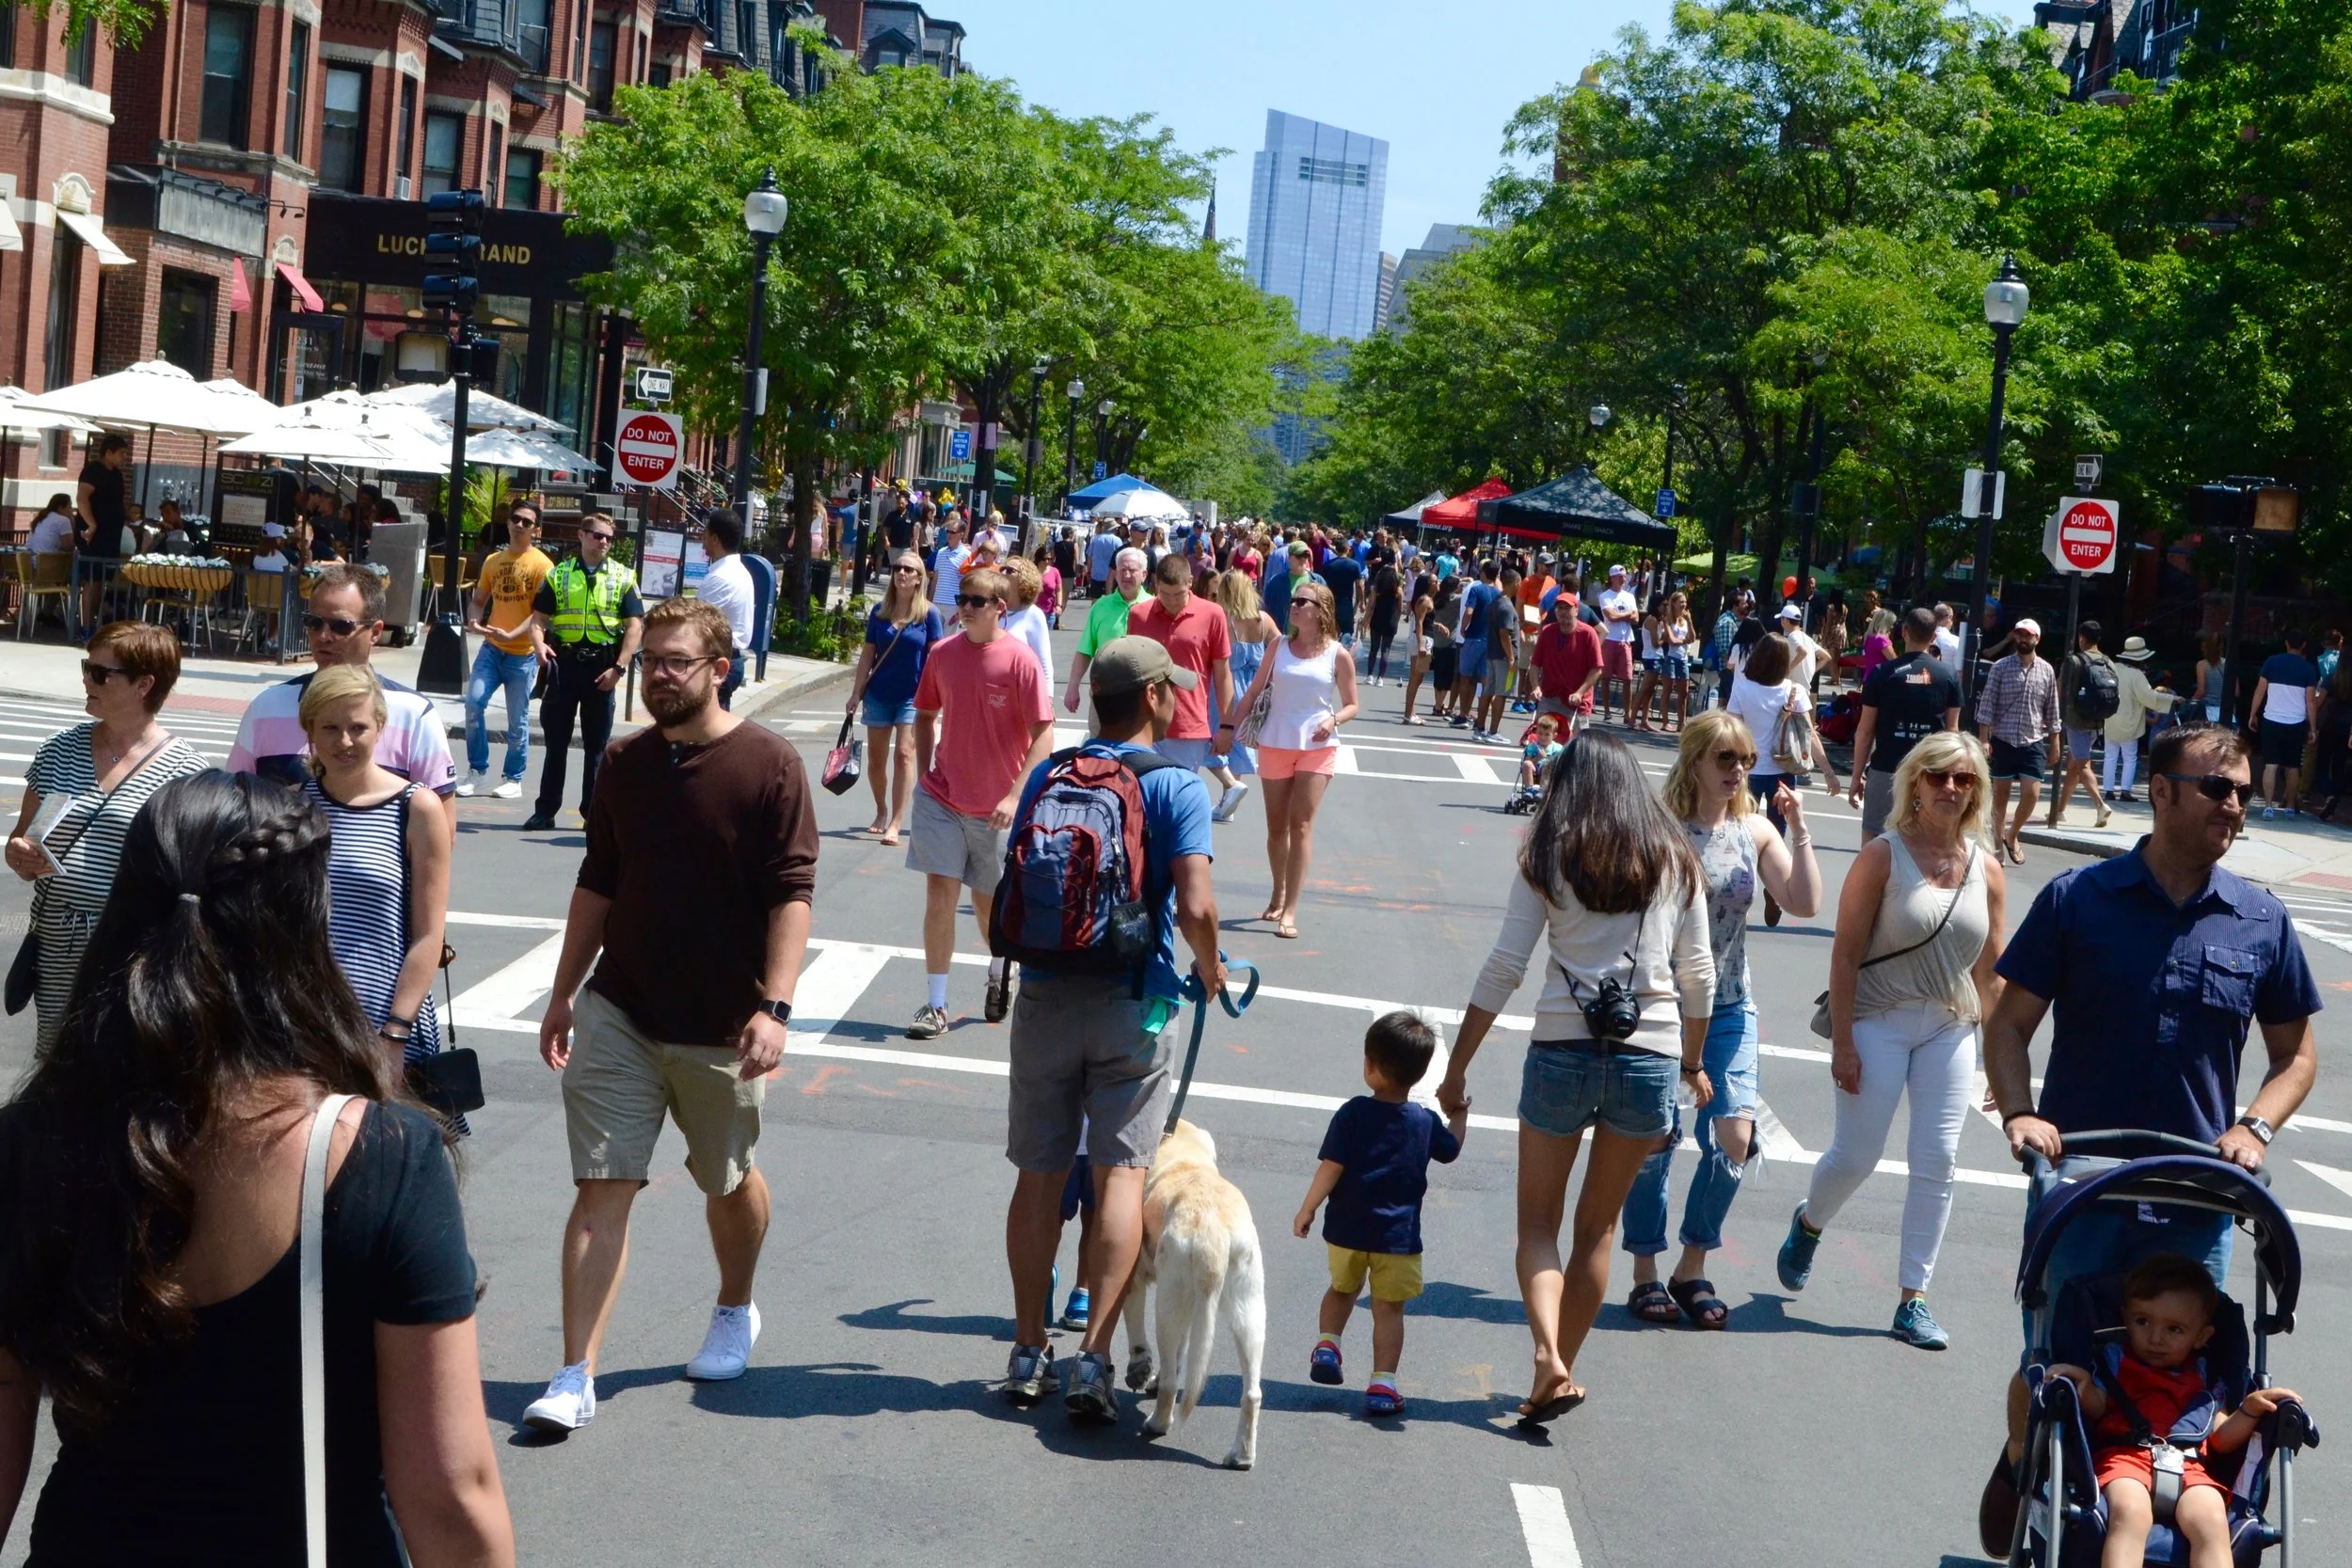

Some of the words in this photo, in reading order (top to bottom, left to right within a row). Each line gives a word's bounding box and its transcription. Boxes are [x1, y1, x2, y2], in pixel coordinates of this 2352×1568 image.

[377, 234, 429, 256] LUC
[480, 243, 532, 265] RAND
[647, 378, 658, 390] ONE
[659, 380, 669, 391] WAY
[627, 427, 644, 439] DO
[647, 430, 672, 443] NOT
[627, 455, 665, 470] ENTER
[2071, 514, 2085, 525] DO
[2088, 515, 2107, 528] NOT
[1593, 526, 1614, 535] SHACK
[2071, 544, 2102, 557] ENTER
[556, 564, 564, 604] BOSTON
